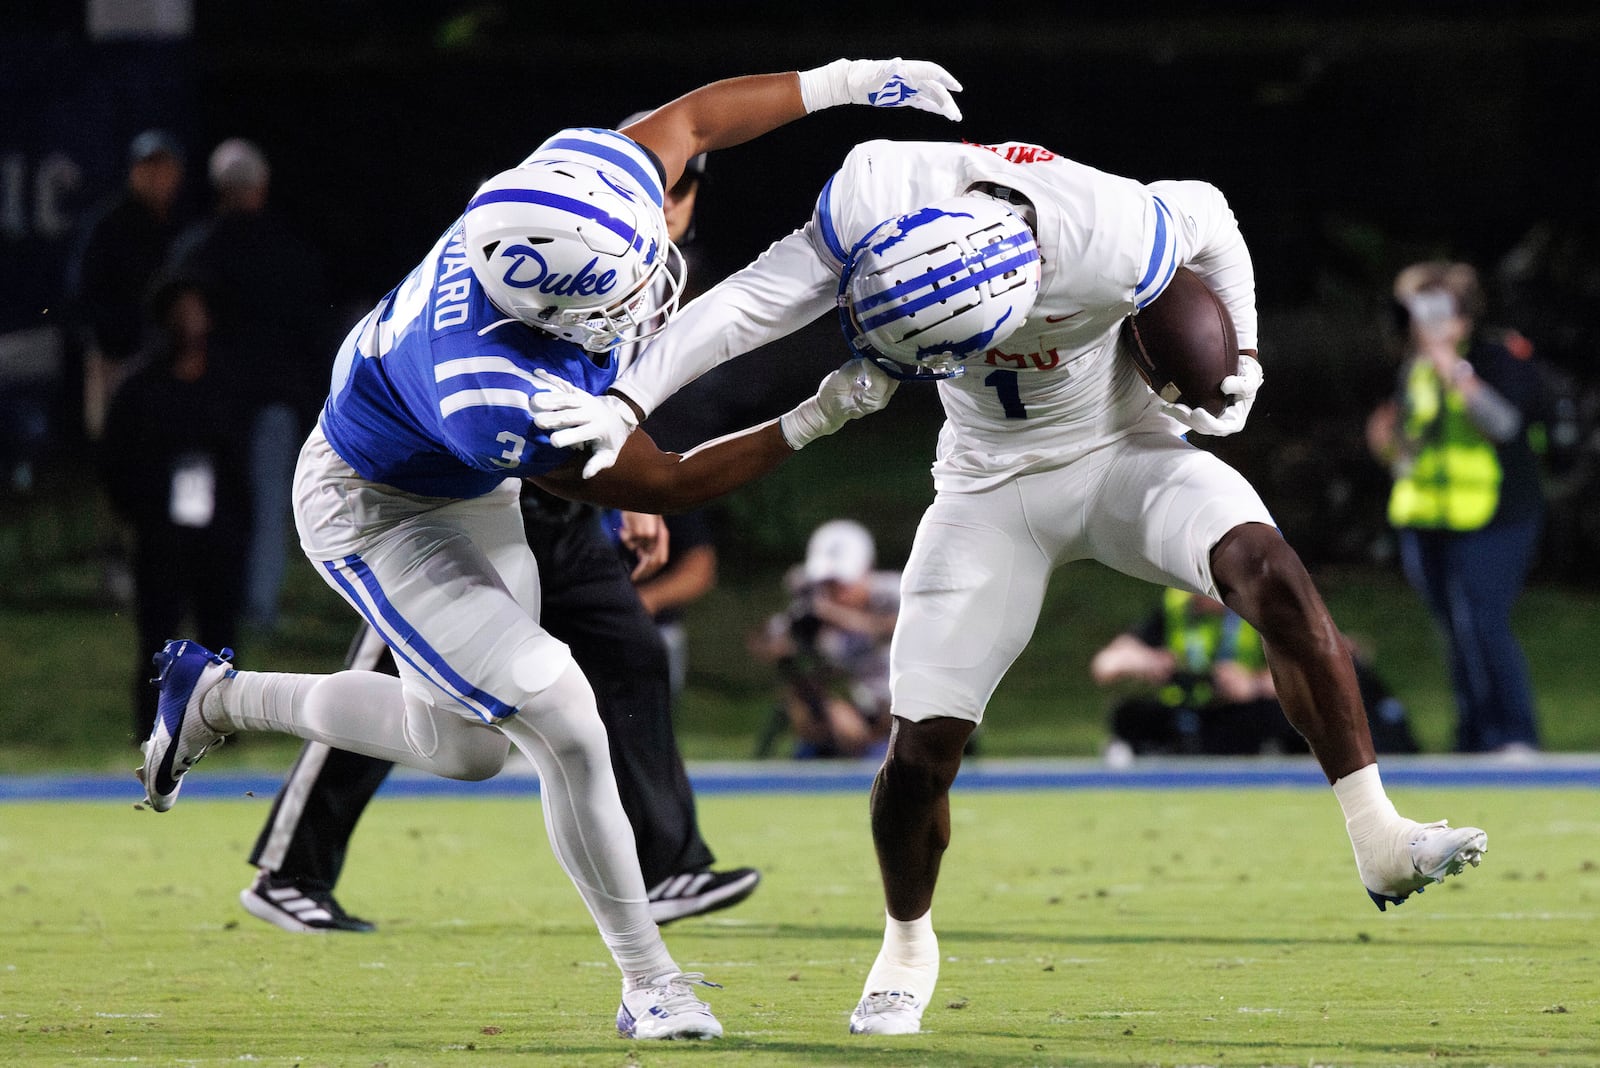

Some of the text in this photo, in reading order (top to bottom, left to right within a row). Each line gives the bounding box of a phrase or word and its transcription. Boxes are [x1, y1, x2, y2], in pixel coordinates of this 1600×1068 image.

[500, 244, 618, 297] Duke
[972, 347, 1060, 371] MU
[984, 369, 1028, 420] 1
[489, 430, 527, 469] 3
